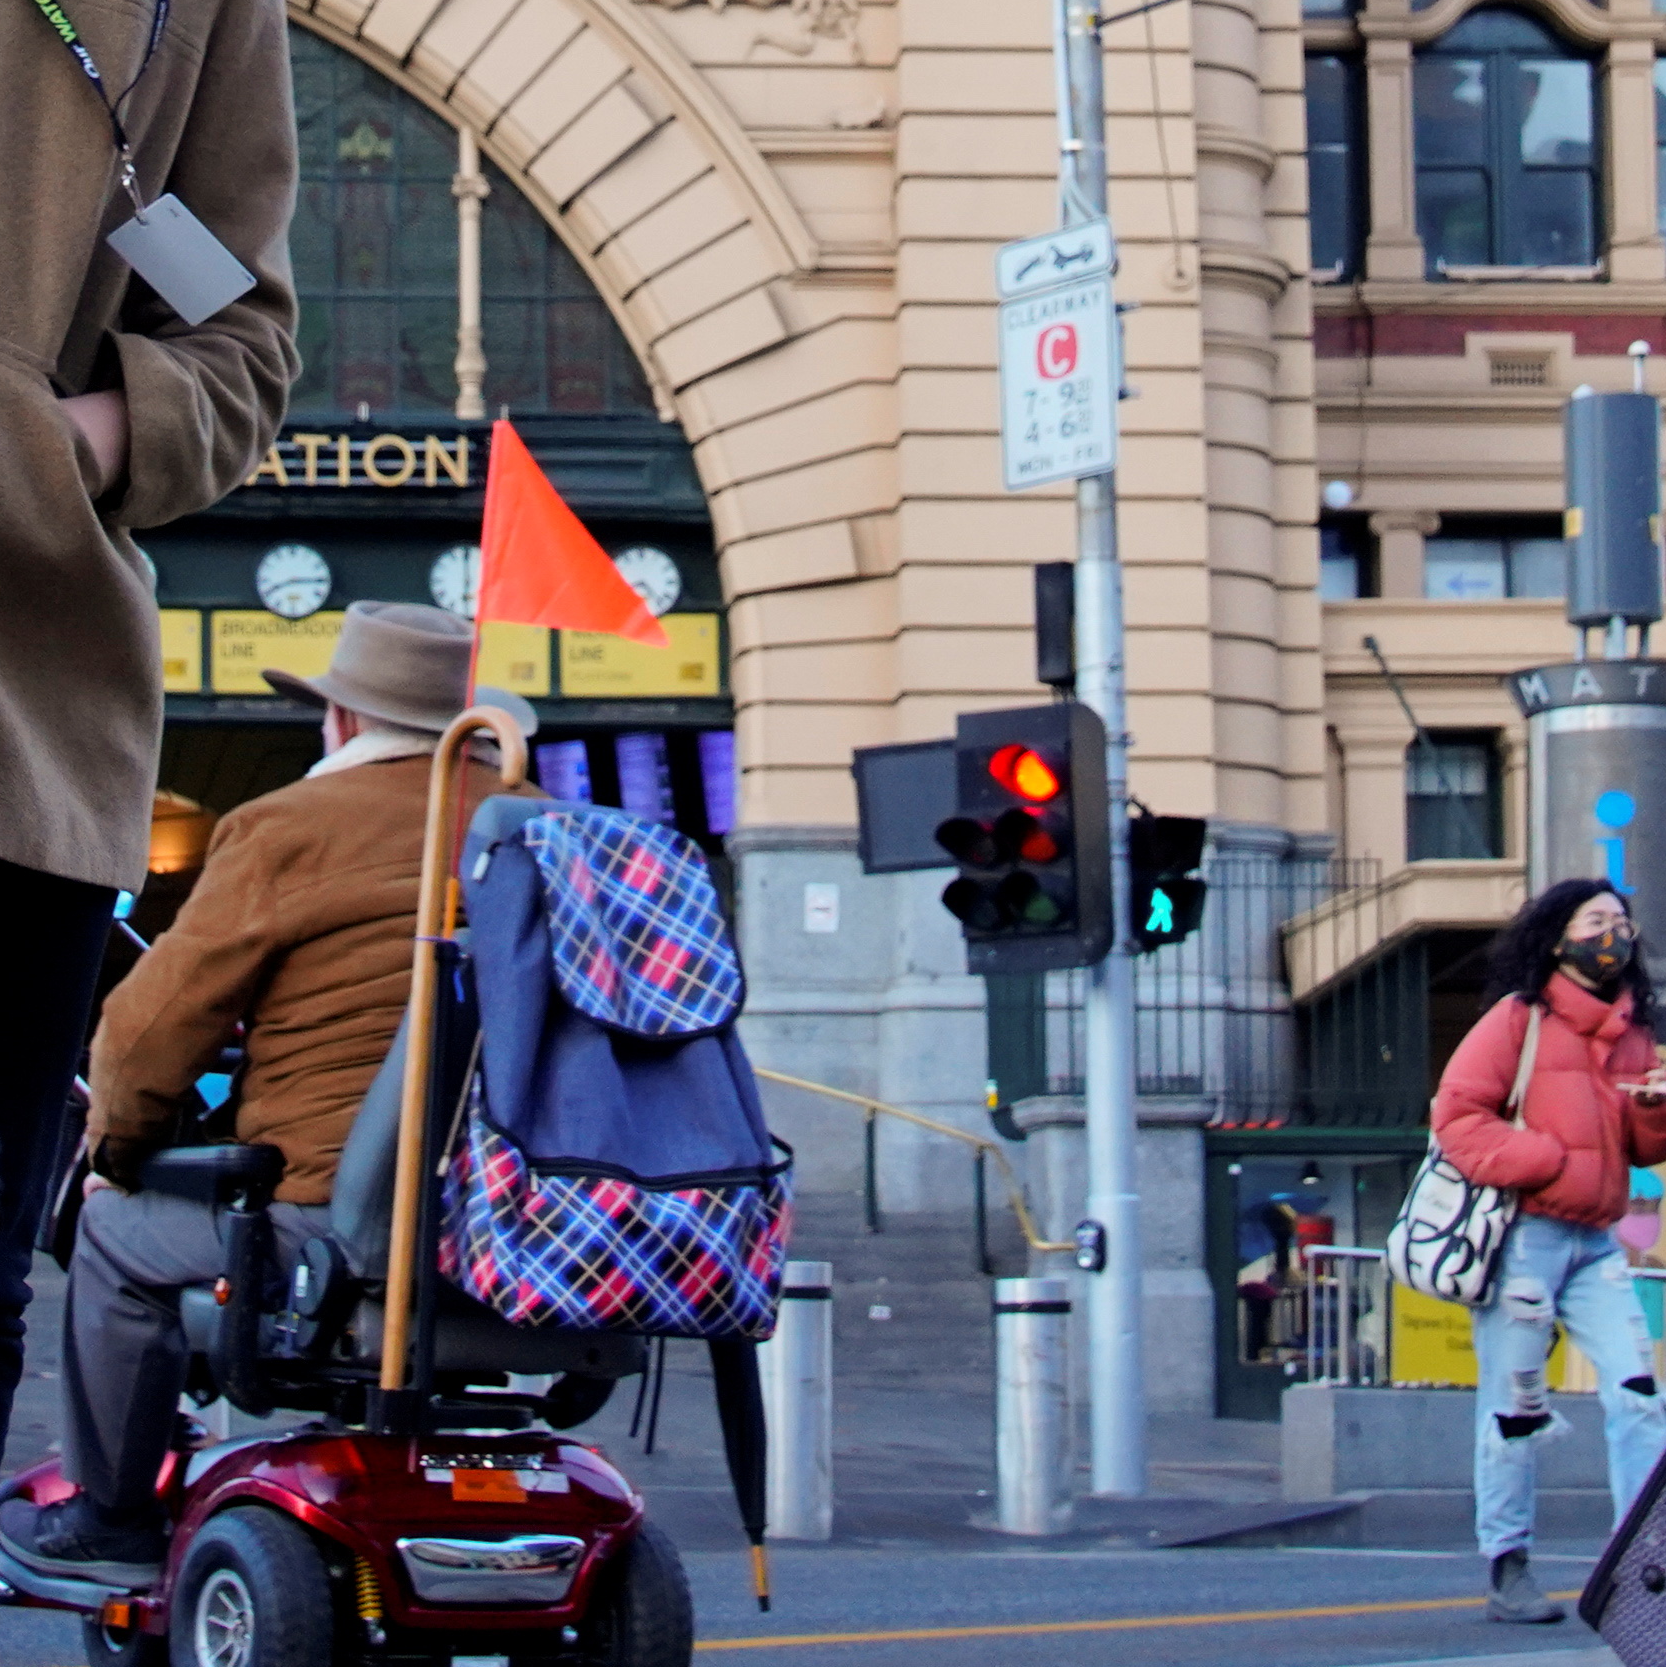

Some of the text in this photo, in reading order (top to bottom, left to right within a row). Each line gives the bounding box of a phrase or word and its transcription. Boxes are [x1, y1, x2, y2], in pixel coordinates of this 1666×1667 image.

[72, 43, 100, 79] Our
[1042, 326, 1071, 377] C
[220, 642, 255, 658] LINE
[568, 644, 604, 661] LINE
